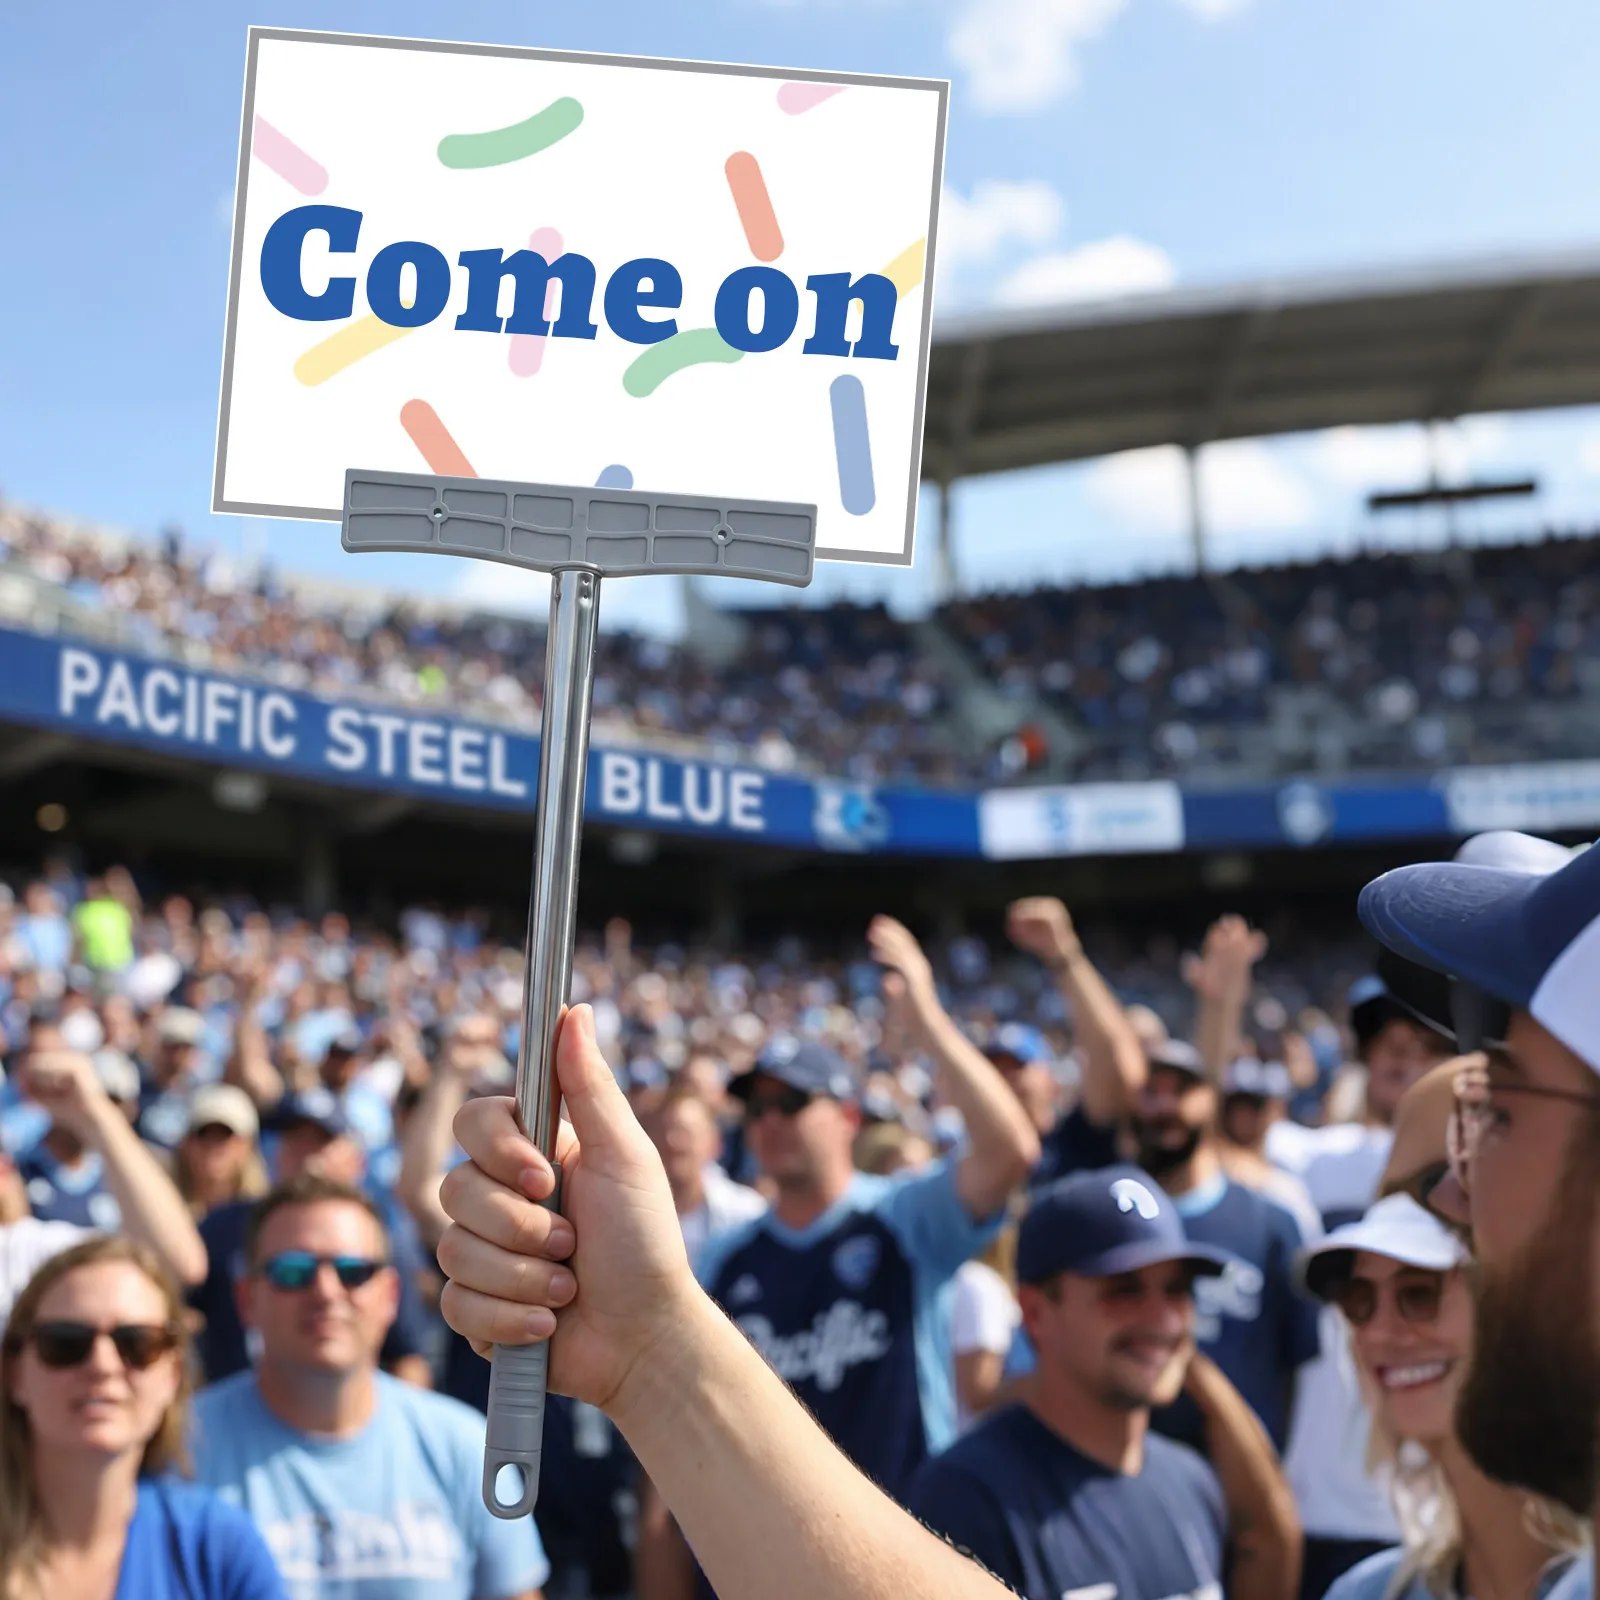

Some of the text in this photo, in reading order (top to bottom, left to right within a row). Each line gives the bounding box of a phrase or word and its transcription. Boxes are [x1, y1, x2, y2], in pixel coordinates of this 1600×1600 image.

[261, 205, 899, 360] Come on
[60, 649, 765, 829] PACIFIC STEEL BLUE
